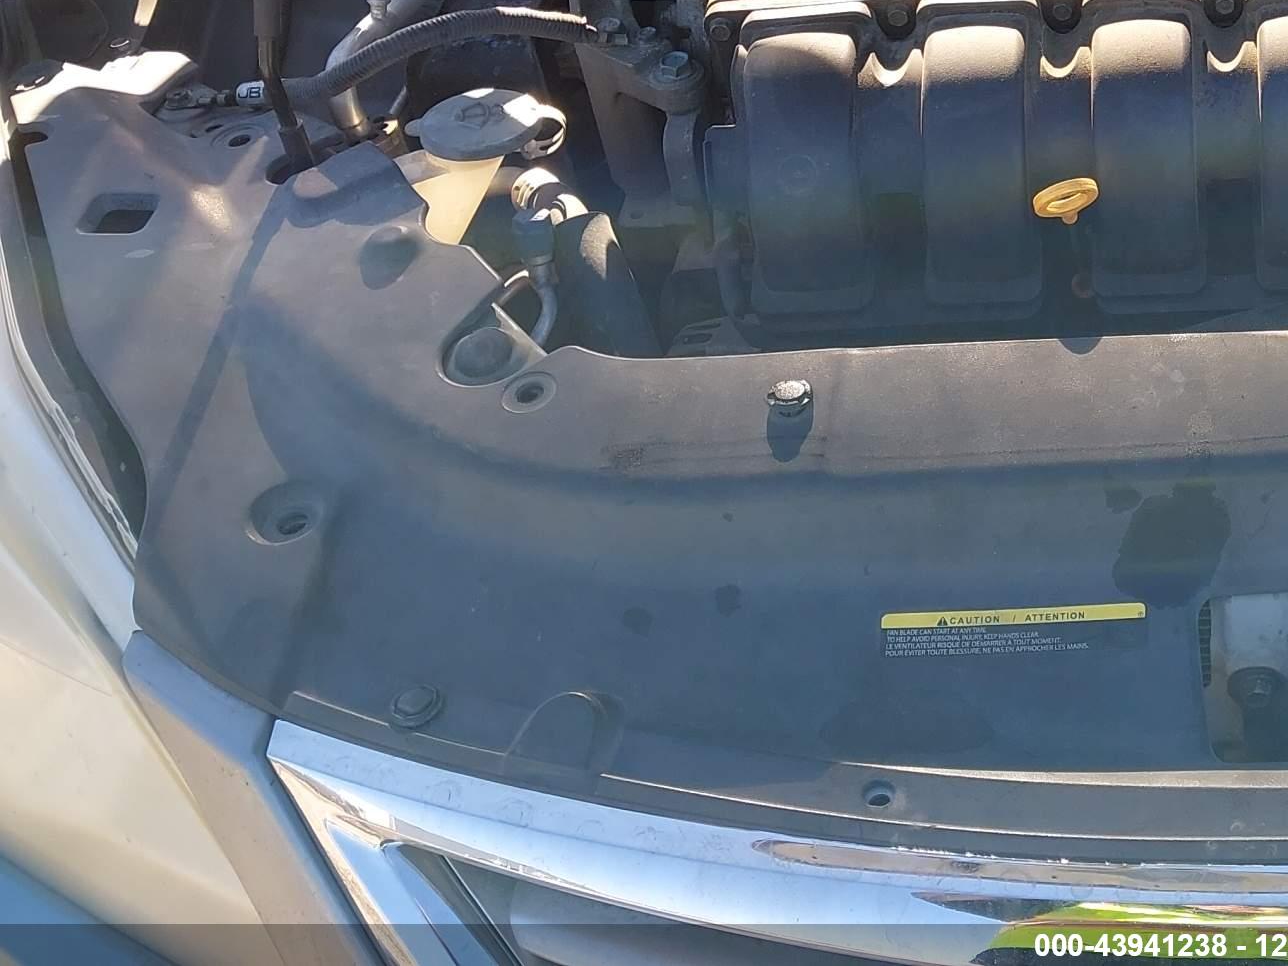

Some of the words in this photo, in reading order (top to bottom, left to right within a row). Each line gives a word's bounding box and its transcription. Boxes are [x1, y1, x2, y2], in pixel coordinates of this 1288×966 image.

[950, 616, 1000, 624] CAUTION
[1024, 612, 1085, 622] ATTENTION
[886, 649, 904, 657] POUR
